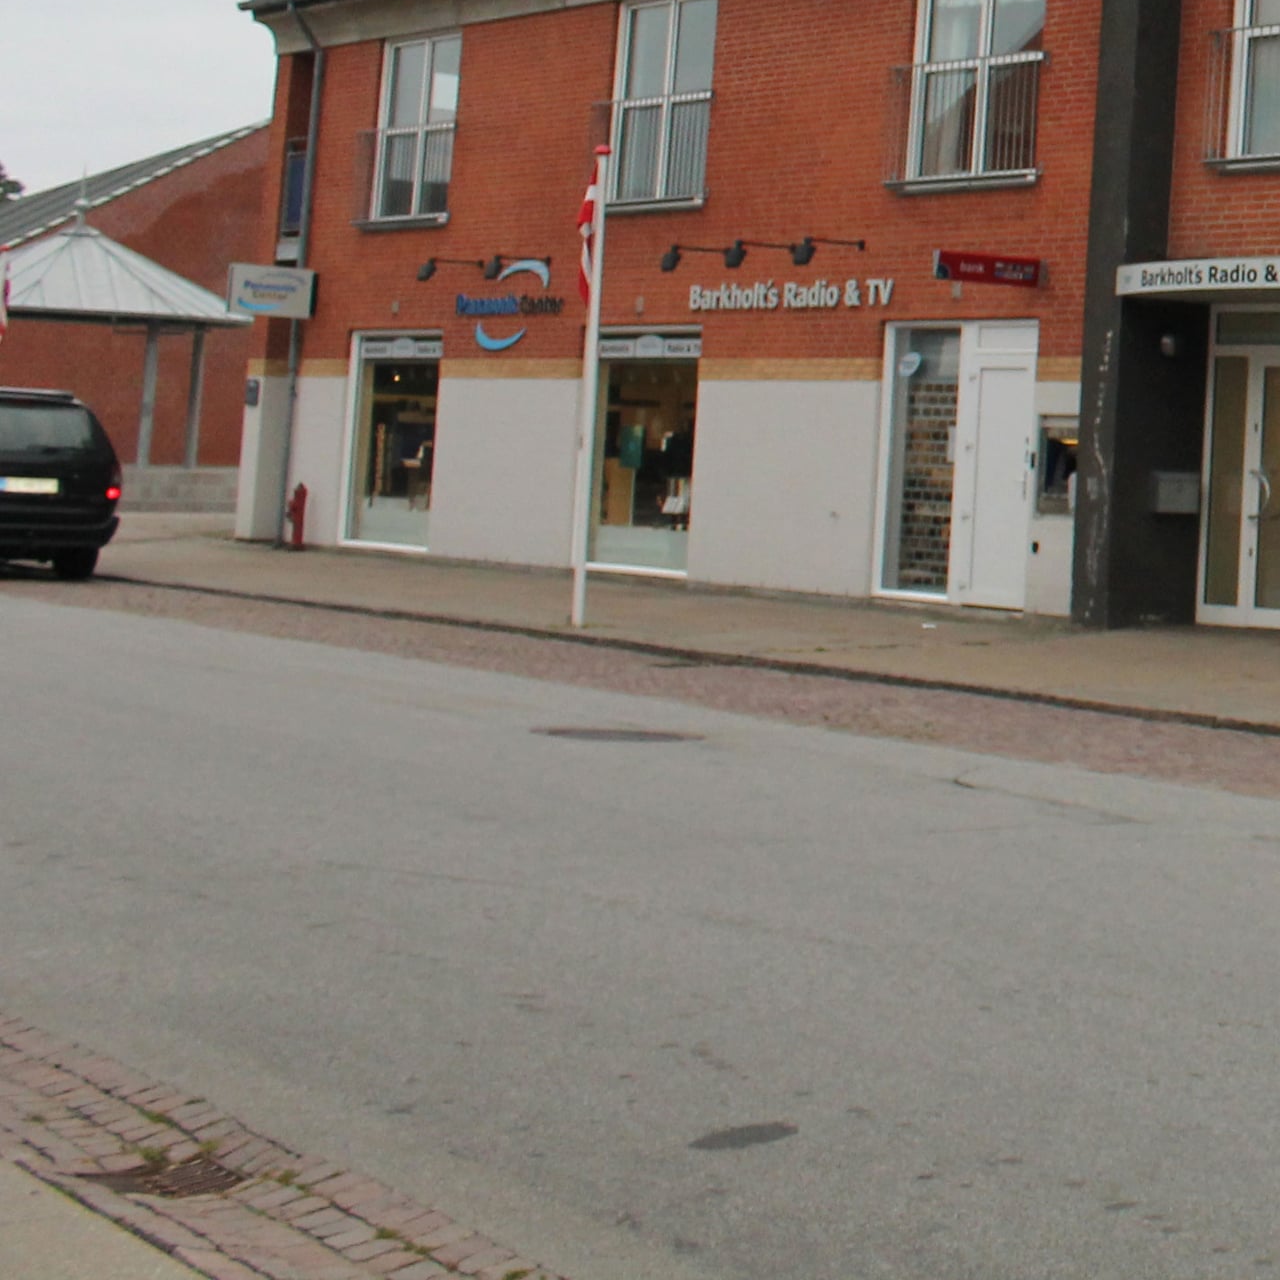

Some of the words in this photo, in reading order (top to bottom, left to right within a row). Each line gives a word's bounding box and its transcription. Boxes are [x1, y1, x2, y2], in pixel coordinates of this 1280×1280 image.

[1208, 264, 1258, 283] Radio
[1263, 264, 1279, 282] &
[783, 278, 840, 309] Radio
[843, 277, 861, 308] &
[865, 277, 895, 306] TV
